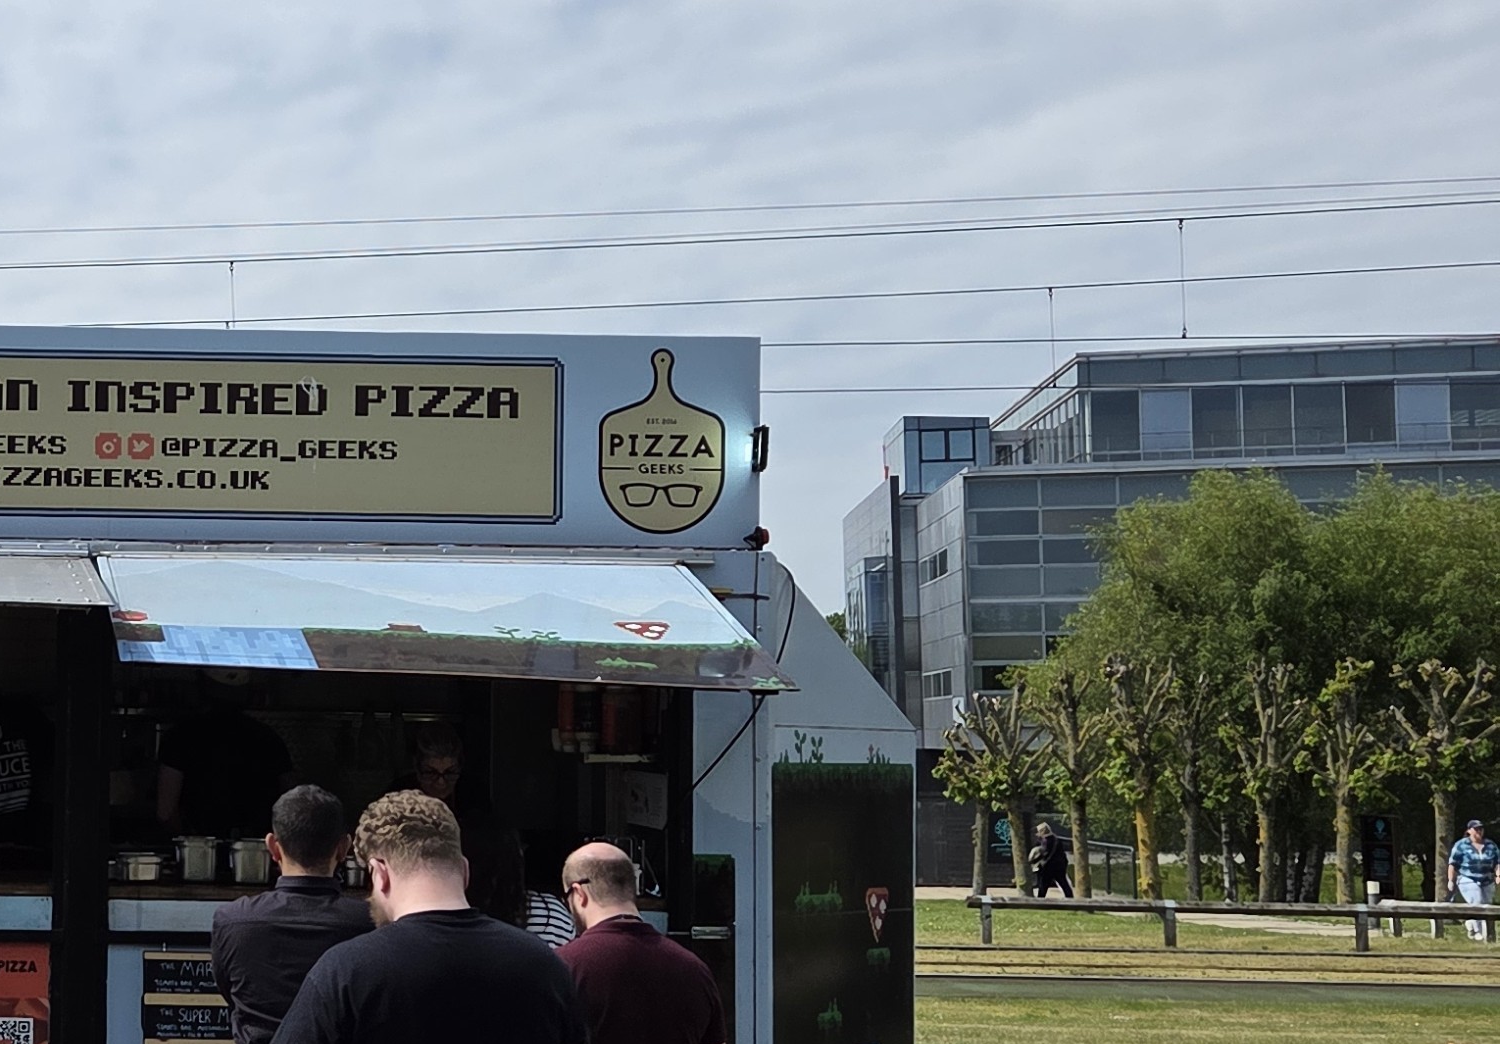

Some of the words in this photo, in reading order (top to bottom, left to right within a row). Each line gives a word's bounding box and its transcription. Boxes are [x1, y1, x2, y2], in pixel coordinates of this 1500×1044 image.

[67, 380, 328, 415] INSPIRED
[355, 385, 519, 418] PIZZA
[161, 437, 398, 462] @PIZZA_GEEKS
[609, 433, 715, 458] PIZZA
[638, 463, 685, 475] GEEKS
[3, 739, 27, 752] THE
[15, 779, 31, 789] YO
[178, 1008, 211, 1023] SUPER
